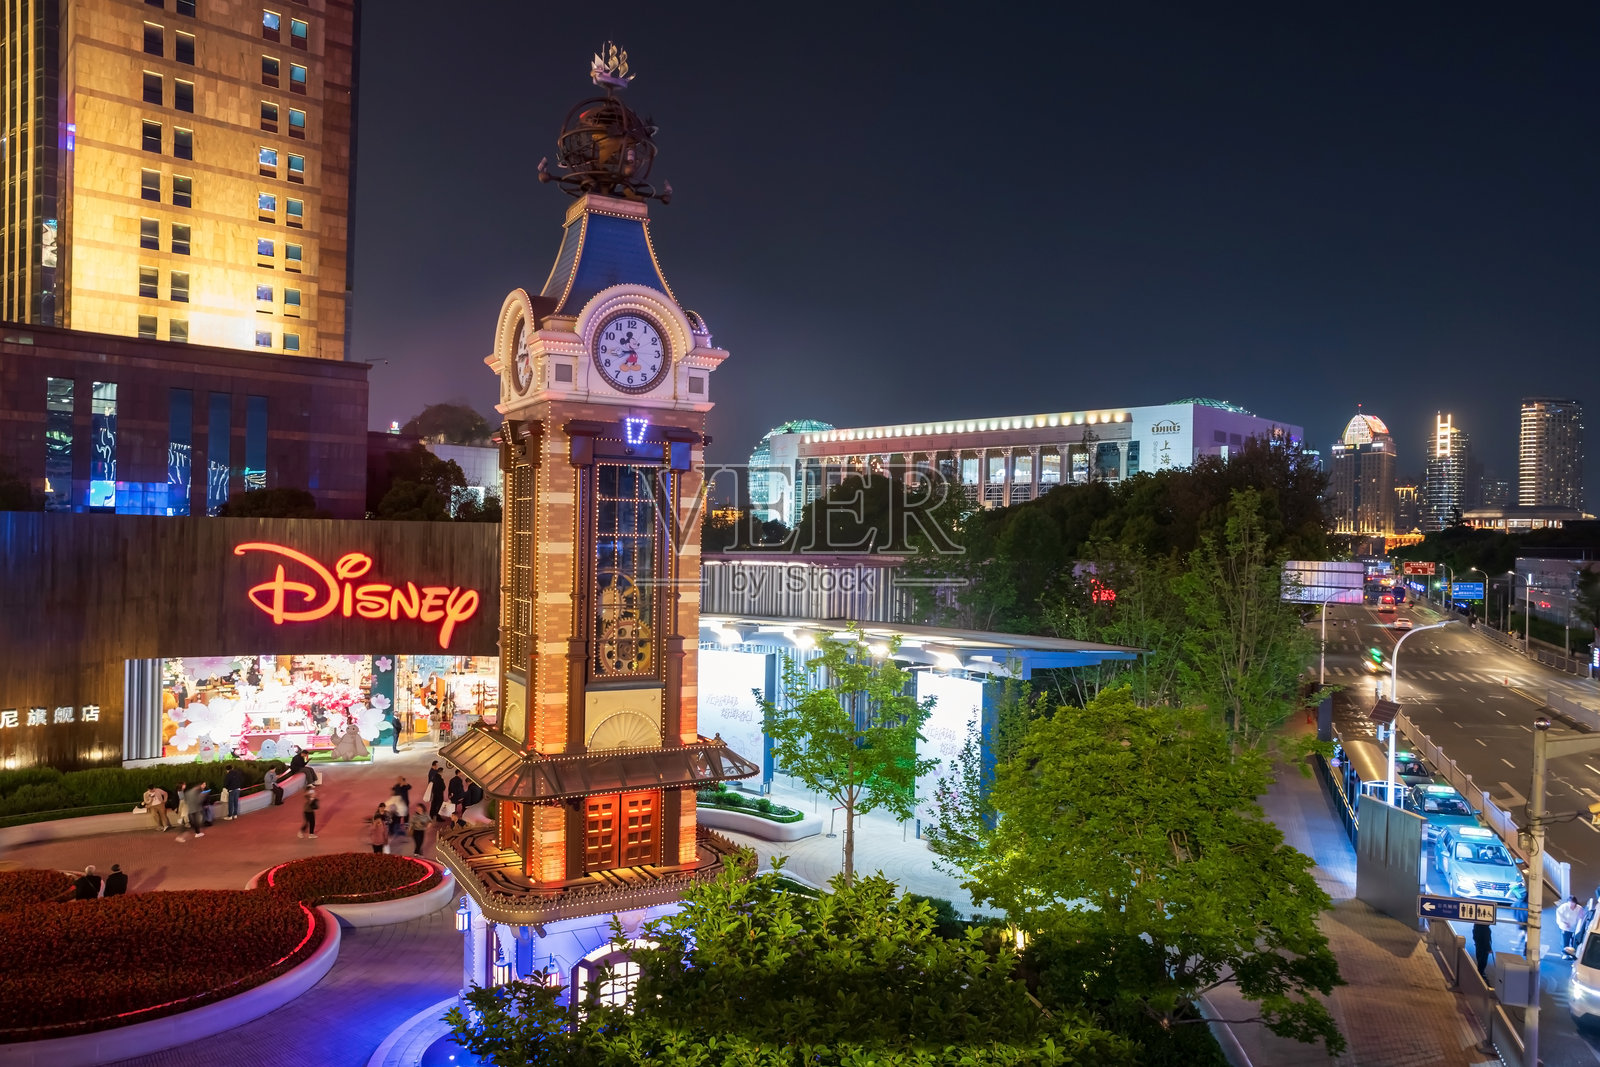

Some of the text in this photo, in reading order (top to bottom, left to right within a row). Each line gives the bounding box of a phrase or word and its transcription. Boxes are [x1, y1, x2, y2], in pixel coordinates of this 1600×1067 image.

[615, 322, 622, 331] 11
[627, 320, 637, 329] 12
[644, 325, 648, 334] 1
[605, 331, 615, 340] 10
[651, 337, 658, 346] 2
[600, 345, 607, 354] 9
[654, 350, 661, 359] 3
[604, 359, 611, 367] 8
[651, 364, 657, 372] 4
[615, 370, 621, 378] 7
[641, 373, 647, 382] 5
[627, 375, 633, 384] 6
[0, 705, 100, 729] 尼旗舰店
